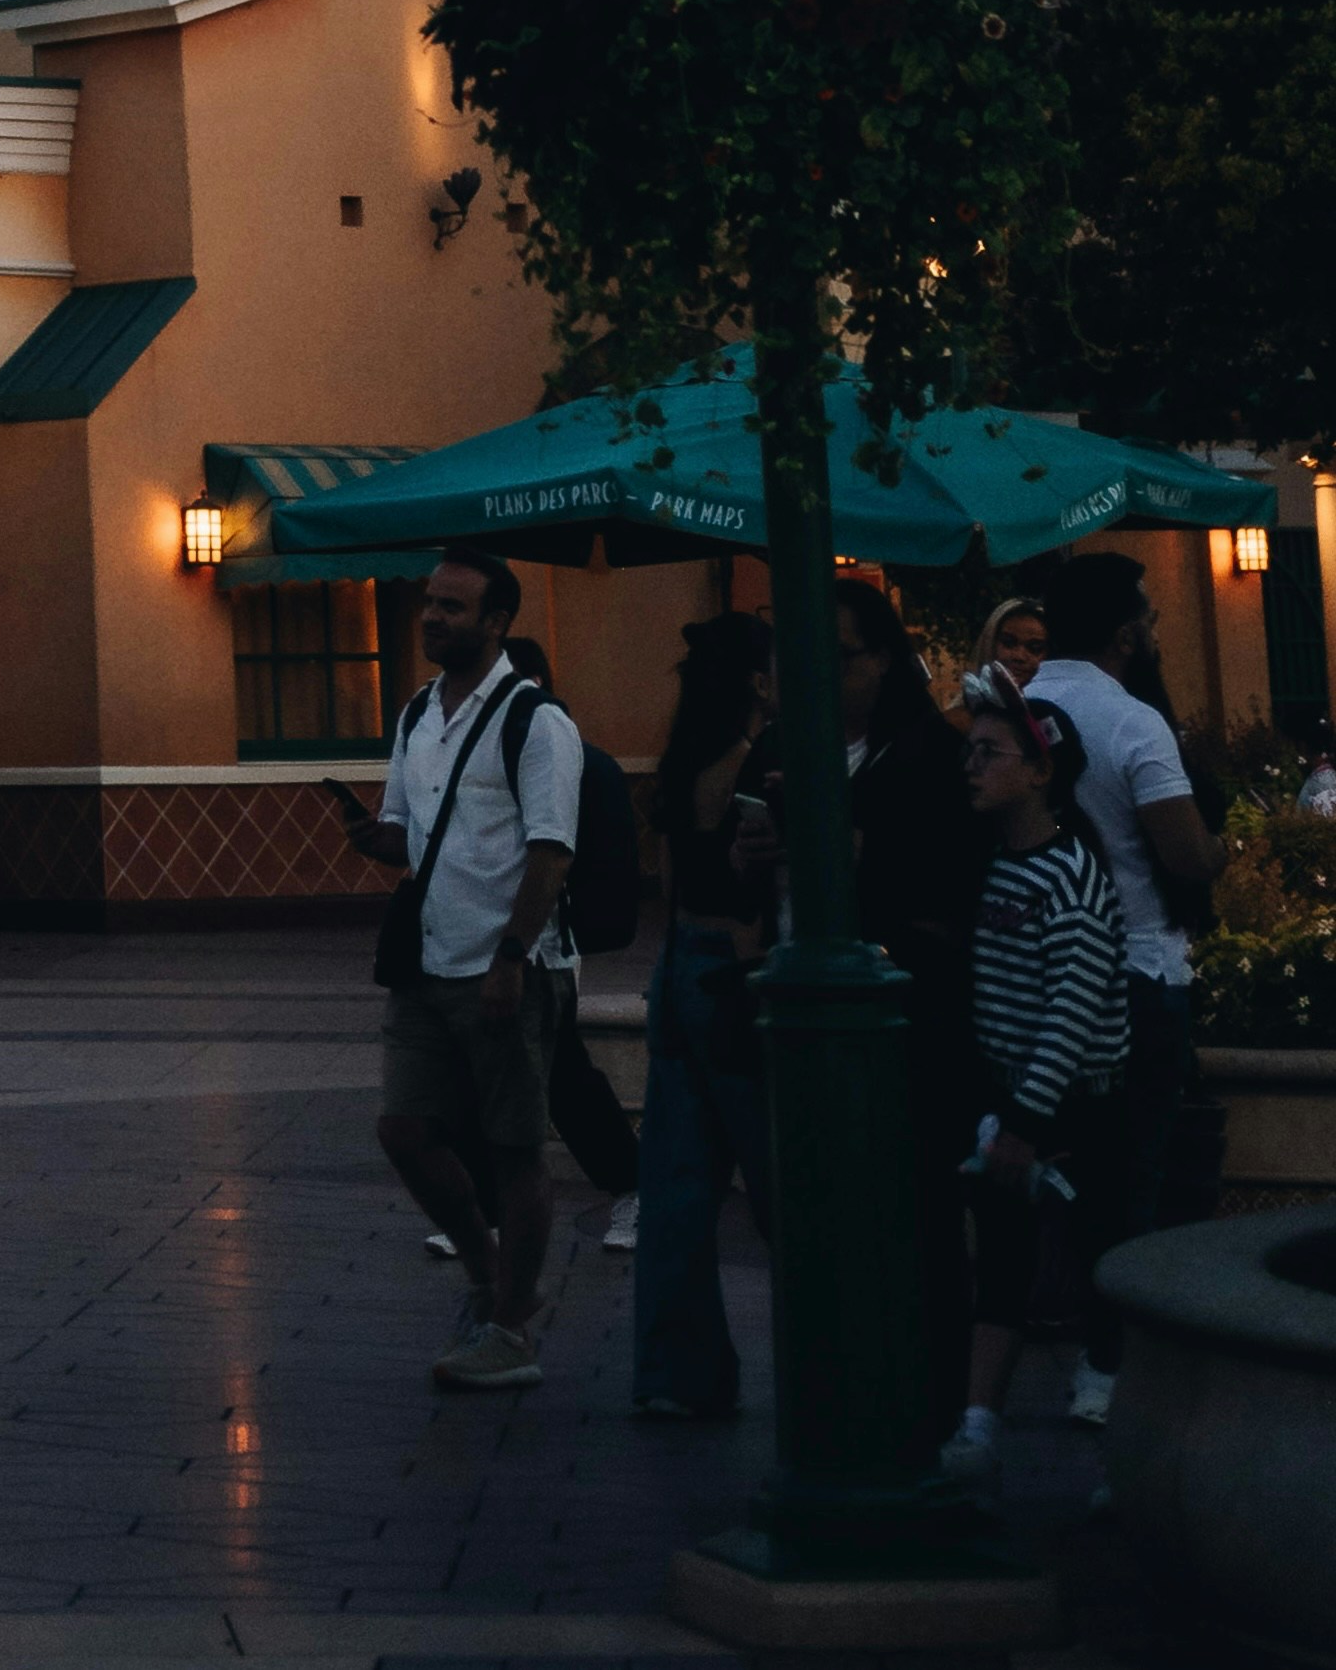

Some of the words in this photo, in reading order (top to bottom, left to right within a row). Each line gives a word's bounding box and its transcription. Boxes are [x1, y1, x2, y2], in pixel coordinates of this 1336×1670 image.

[484, 491, 534, 519] PLANS
[538, 487, 566, 512] DES
[571, 480, 619, 507] PARCS
[699, 501, 746, 530] MAPS
